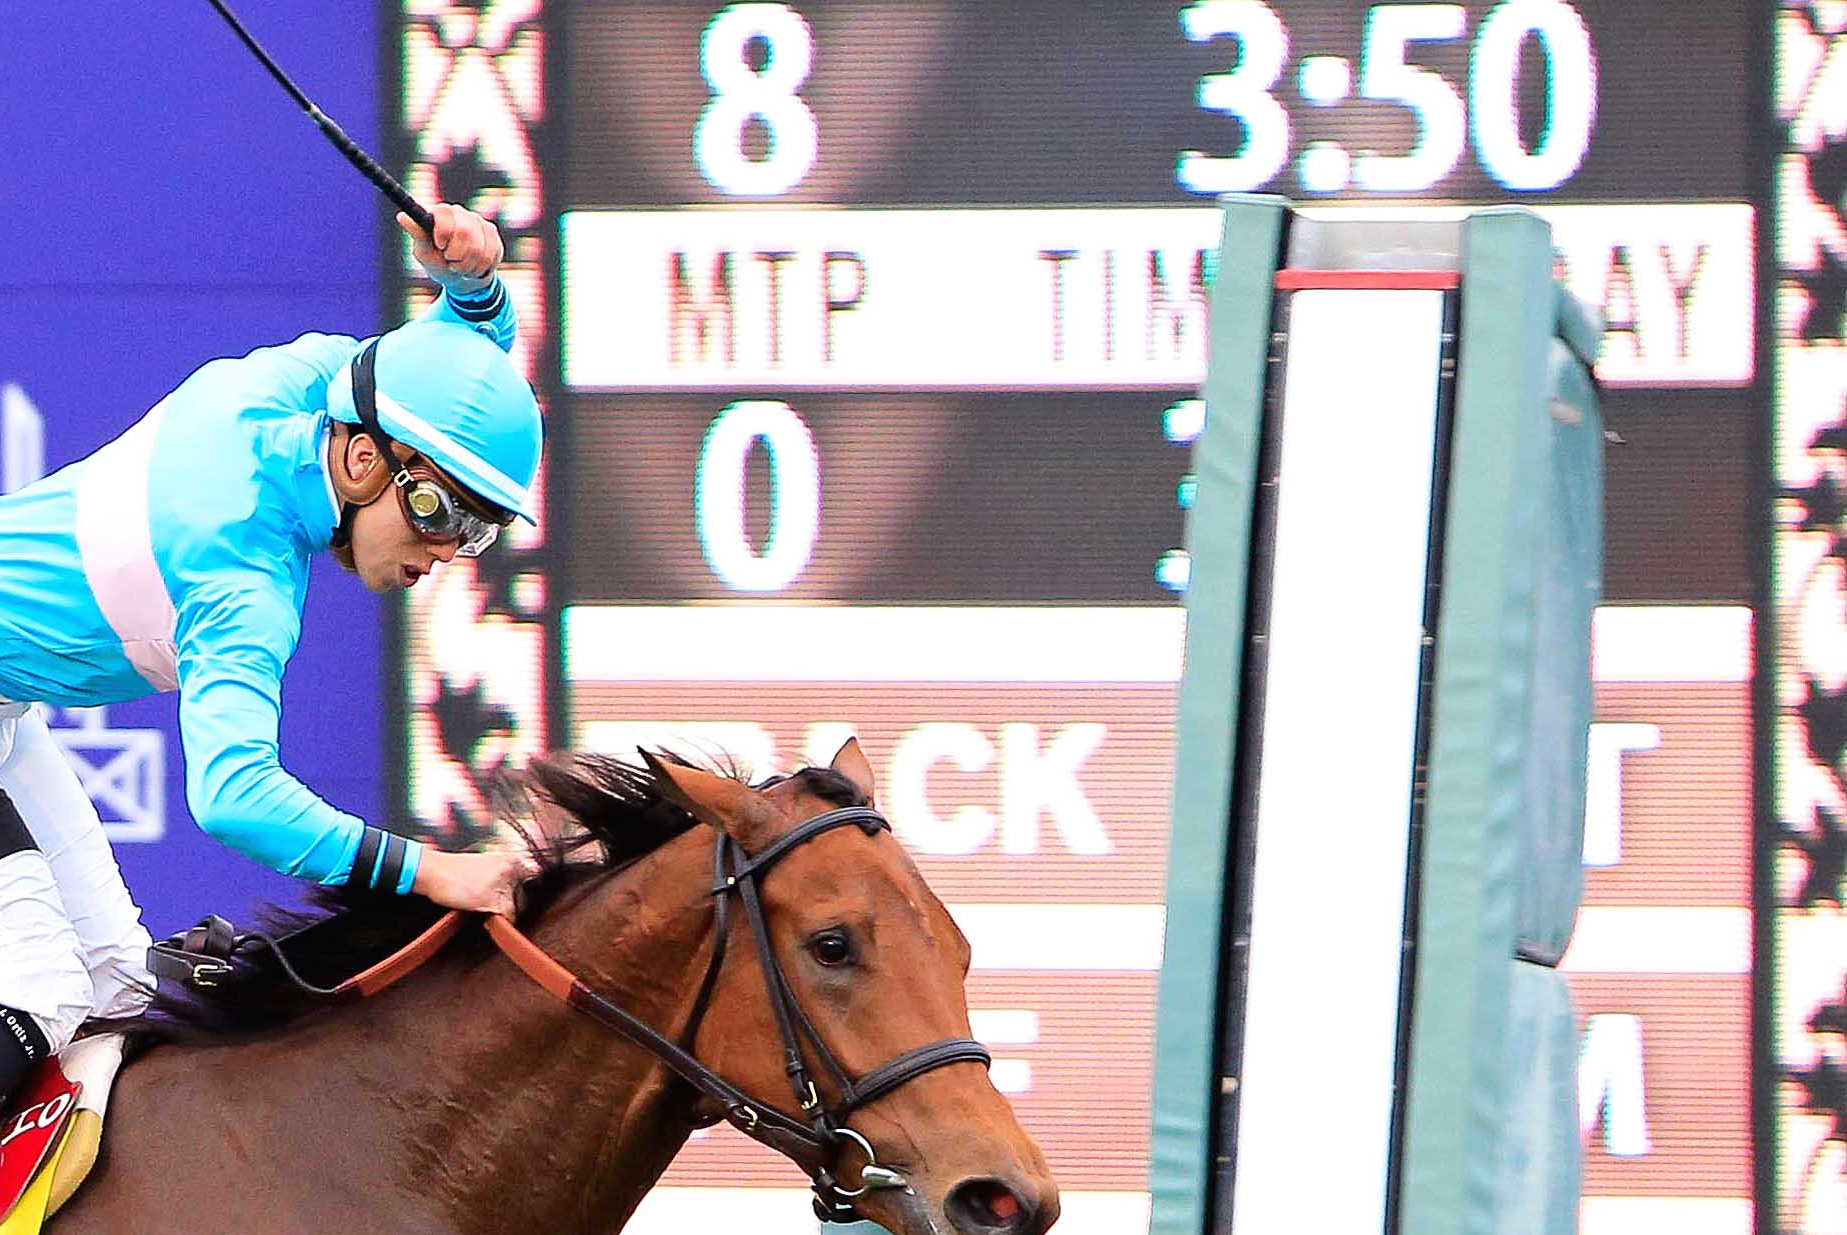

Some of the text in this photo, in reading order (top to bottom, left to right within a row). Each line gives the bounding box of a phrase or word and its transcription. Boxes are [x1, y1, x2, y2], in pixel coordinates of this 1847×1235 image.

[693, 3, 820, 196] 8
[1175, 0, 1601, 192] 3:50
[664, 250, 871, 370] MTP
[1037, 244, 1711, 363] TIM AY
[696, 401, 821, 591] 0
